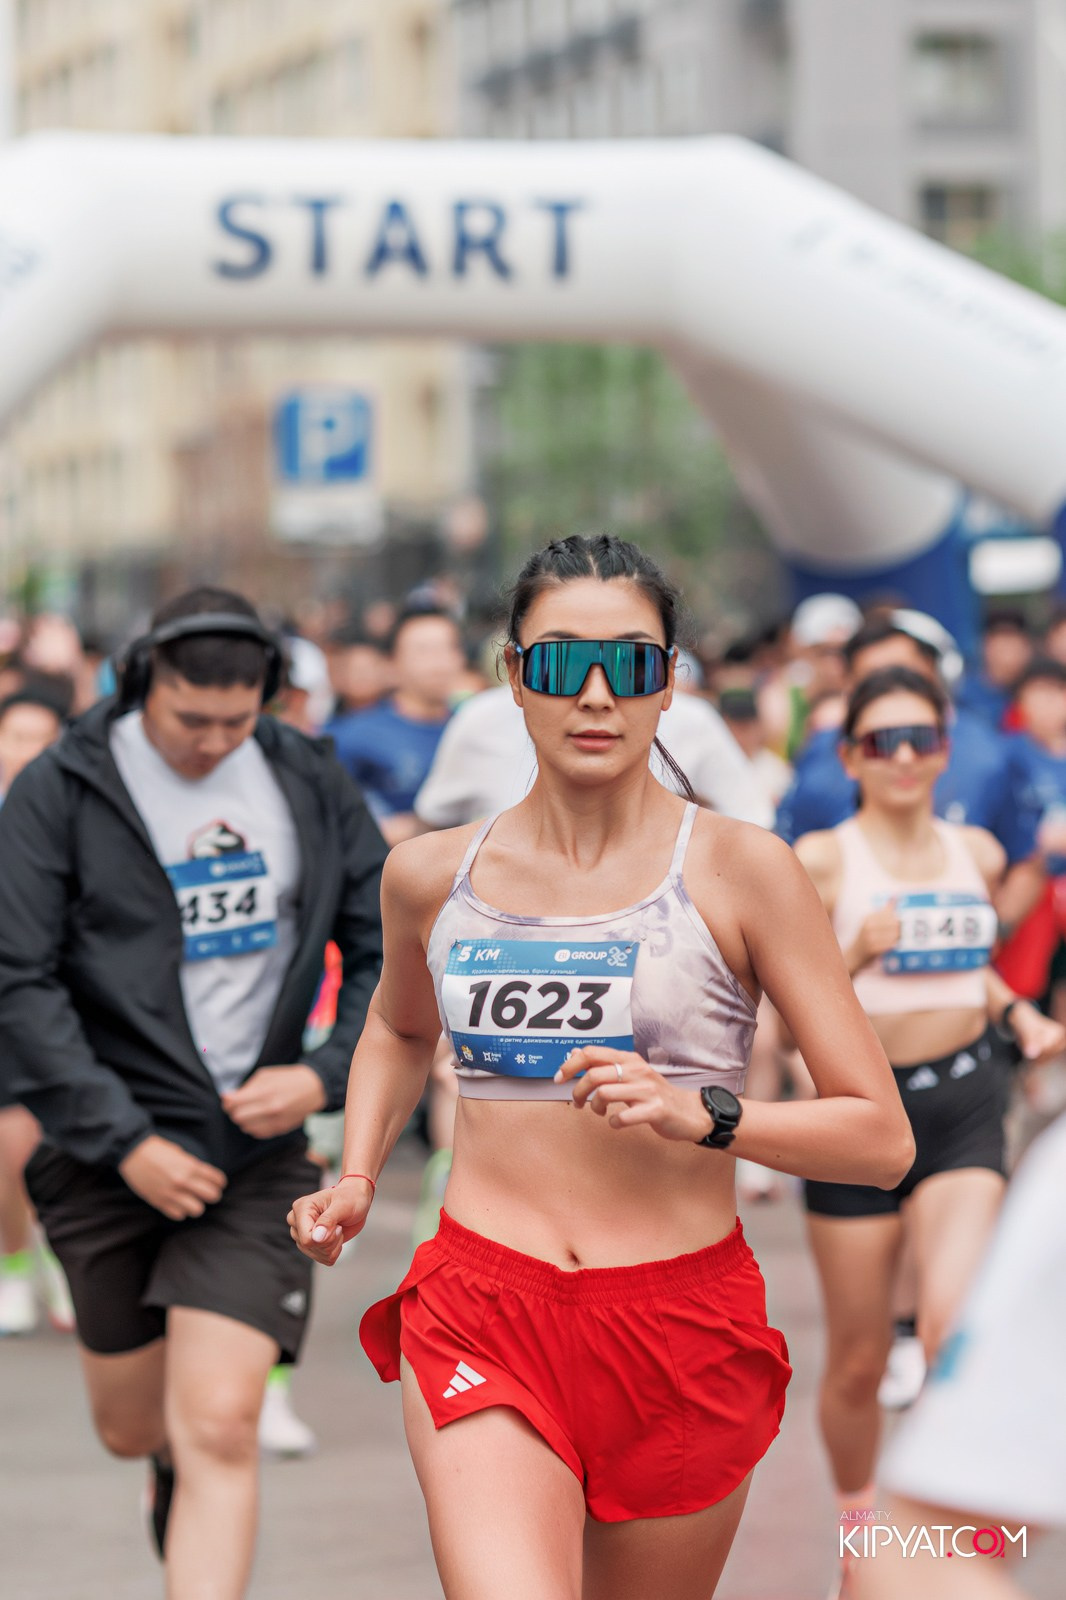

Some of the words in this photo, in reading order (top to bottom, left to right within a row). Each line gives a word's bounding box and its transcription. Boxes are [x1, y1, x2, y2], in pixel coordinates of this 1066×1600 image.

[212, 193, 587, 281] START
[457, 946, 473, 962] 5
[474, 949, 501, 961] KM
[571, 951, 607, 960] GROUP
[468, 981, 611, 1030] 1623
